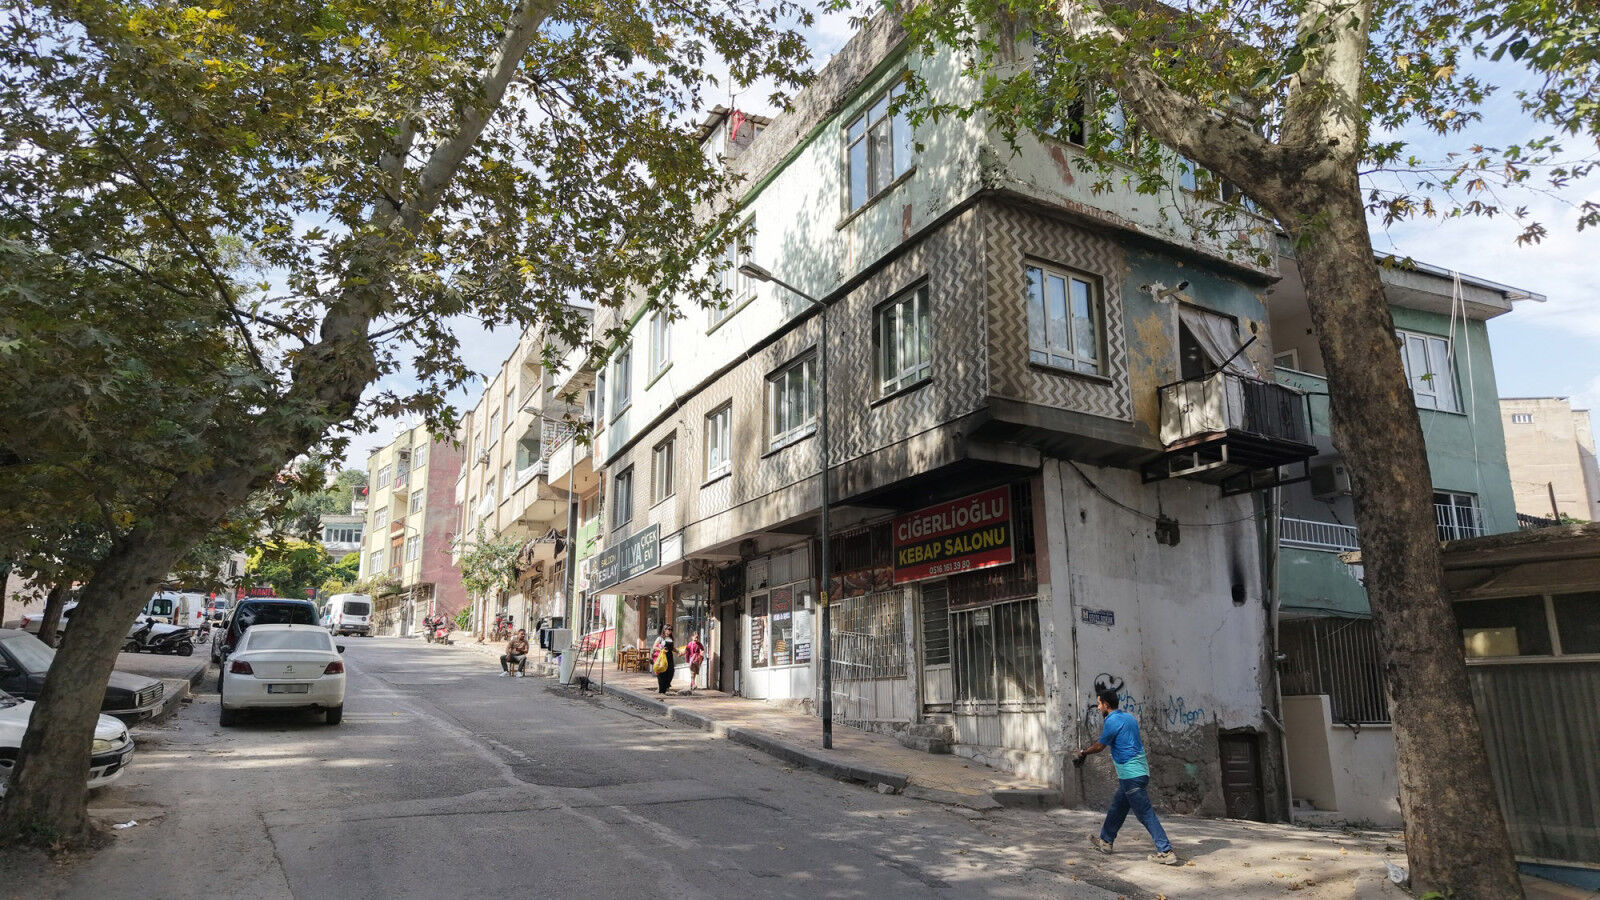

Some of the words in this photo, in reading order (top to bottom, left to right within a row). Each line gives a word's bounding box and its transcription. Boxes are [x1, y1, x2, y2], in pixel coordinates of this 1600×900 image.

[898, 497, 1004, 541] CİĞERLİOĞLU
[899, 541, 941, 565] KEBAP
[944, 527, 1005, 556] SALONU
